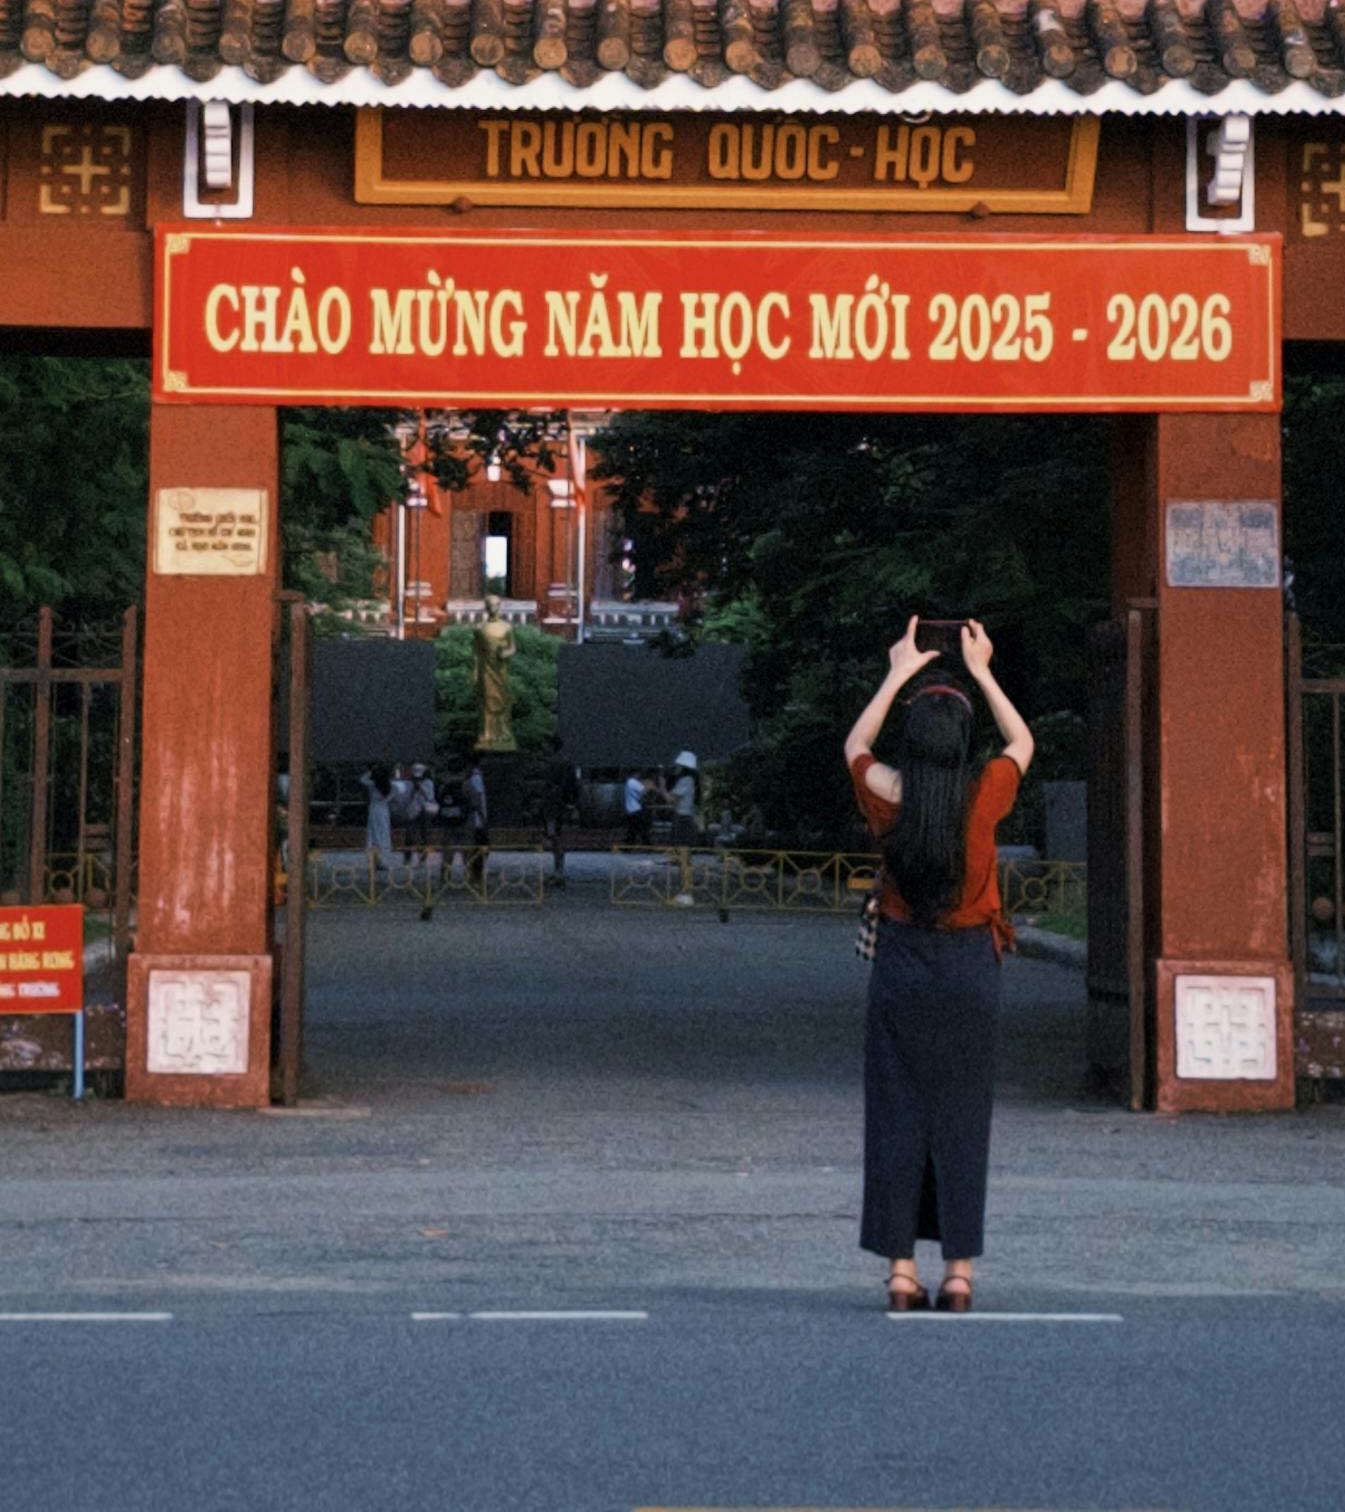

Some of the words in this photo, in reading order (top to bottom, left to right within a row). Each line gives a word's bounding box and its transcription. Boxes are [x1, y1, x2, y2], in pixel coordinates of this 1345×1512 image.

[204, 266, 352, 355] CHÀO
[369, 269, 528, 358] MỪNG
[544, 272, 663, 358] NĂM
[679, 291, 791, 375] HỌC
[808, 273, 911, 361] MỚI
[928, 291, 1054, 362] 2025
[1072, 328, 1088, 341] -
[1106, 292, 1233, 362] 2026
